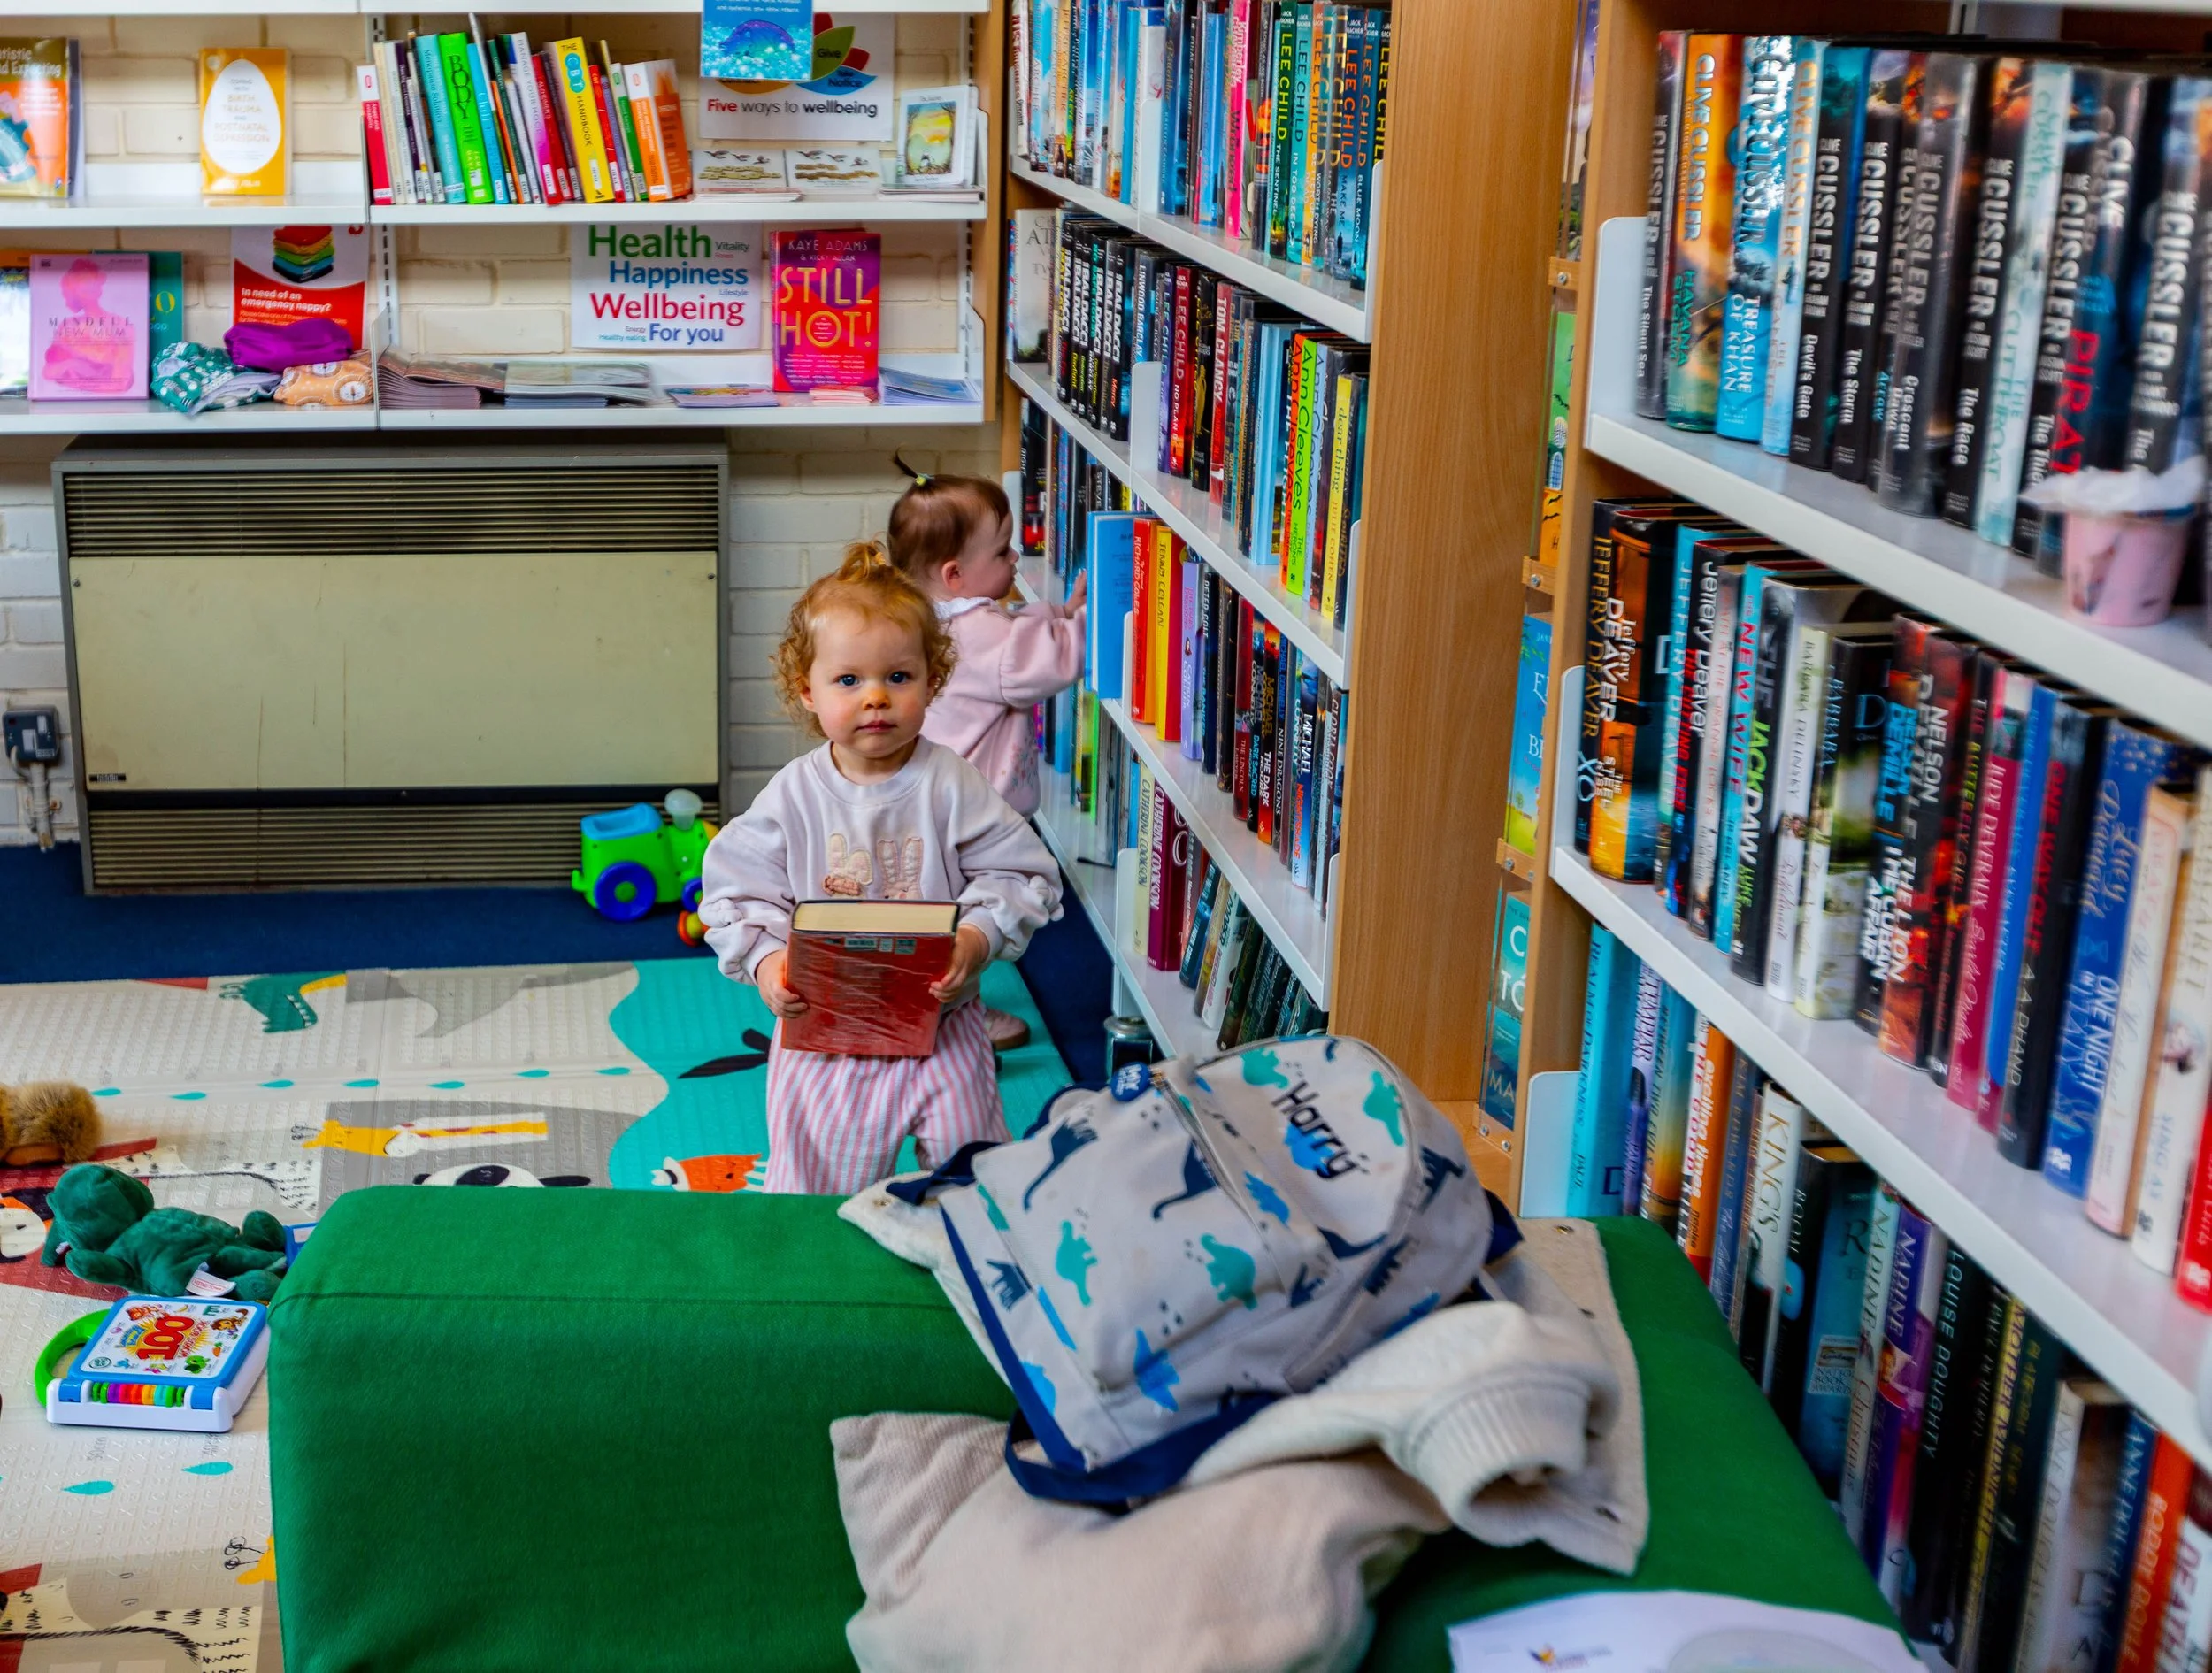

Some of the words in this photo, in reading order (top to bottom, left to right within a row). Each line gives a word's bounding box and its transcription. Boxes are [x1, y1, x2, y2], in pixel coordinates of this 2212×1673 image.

[817, 48, 841, 58] Give
[827, 78, 863, 88] Notice
[1280, 33, 1293, 74] LEE
[1298, 40, 1309, 76] LEE
[1344, 49, 1357, 91] LEE
[1362, 44, 1373, 87] LEE
[449, 55, 472, 119] BODY
[708, 98, 737, 112] Five
[742, 100, 780, 117] ways
[785, 100, 798, 113] to
[804, 99, 878, 118] wellbeing
[1277, 80, 1290, 141] CHILD
[1294, 81, 1308, 142] CHILD
[1309, 82, 1321, 144] CHILD
[1694, 53, 1716, 125] CLIVE
[1797, 58, 1818, 134] CLIVE
[577, 96, 593, 147] HANDBOOK
[1340, 97, 1356, 168] CHILD
[1356, 94, 1371, 167] CHILD
[1271, 166, 1280, 214] SENTINEL
[1292, 152, 1298, 165] IN
[1647, 130, 1668, 247] CUSSLER
[1683, 130, 1711, 242] CUSSLER
[1339, 210, 1345, 227] ME
[1354, 207, 1363, 242] MOON
[1780, 139, 1809, 257] CUSSLER
[1809, 154, 1840, 280] CUSSLER
[1852, 158, 1886, 288] CUSSLER
[588, 224, 711, 258] Health
[715, 241, 750, 252] Vitality
[788, 240, 819, 252] KAYE
[826, 241, 868, 252] ADAMS
[1969, 178, 2011, 317] CUSSLER
[2045, 191, 2087, 341] CUSSLER
[241, 298, 294, 310] emergency
[296, 301, 332, 312] nappy?
[252, 289, 273, 299] need
[275, 290, 287, 299] of
[610, 260, 749, 289] Happiness
[780, 266, 872, 304] STILL
[1073, 258, 1083, 342] BALDACCI
[2142, 211, 2194, 370] CUSSLER
[49, 317, 134, 326] MINDFUL
[589, 292, 744, 326] Wellbeing
[649, 323, 680, 342] For
[687, 326, 724, 345] you
[780, 310, 872, 348] HOT!
[1094, 267, 1104, 354] BALDACCI
[1112, 273, 1124, 363] BALDACCI
[1134, 312, 1145, 357] BARCLAY
[1179, 295, 1187, 326] LEE
[1219, 296, 1228, 325] TOM
[1677, 269, 1696, 366] HAVANA
[1732, 293, 1747, 324] OF
[1175, 330, 1186, 380] CHILD
[1214, 334, 1227, 402] CLANCY
[1299, 344, 1316, 395] Ann
[1722, 330, 1743, 394] KHAN
[1736, 295, 1762, 395] TREASURE
[1801, 334, 1819, 380] Devil's
[1847, 349, 1863, 376] The
[1338, 407, 1348, 445] dear
[1795, 383, 1812, 419] Gate
[1840, 378, 1859, 424] Storm
[1899, 373, 1919, 451] Crescent
[1957, 388, 1979, 418] The
[1986, 310, 2022, 483] CUTTHROAT
[2050, 329, 2100, 475] PIRAT
[1292, 397, 1312, 510] Cleeves
[1329, 447, 1346, 497] thing
[1953, 425, 1976, 467] Race
[1157, 576, 1166, 628] COLGAN
[1587, 536, 1613, 634] JEFFERY
[1598, 597, 1624, 722] DEAVER
[1615, 618, 1639, 682] Jeffery
[1736, 622, 1757, 703] NEW
[1795, 641, 1816, 714] BARBARA
[1582, 638, 1607, 739] DEAVER
[1690, 648, 1714, 739] Deaver
[1302, 713, 1315, 774] MICHAEL
[1820, 676, 1845, 767] BARBARA
[1249, 760, 1258, 798] SACRED
[1274, 756, 1284, 816] DRAGONS
[1576, 751, 1598, 802] XO
[1726, 712, 1749, 796] WIFE
[1786, 719, 1808, 801] DELINSKY
[1919, 705, 1950, 803] NELSON
[1141, 779, 1151, 840] CATHERINE
[1740, 713, 1770, 866] JACKDAW
[1985, 762, 2007, 812] JUDE
[2044, 759, 2069, 824] ONE
[1153, 787, 1164, 856] CATHERINE
[1294, 783, 1304, 860] NIGHTSHADE
[1137, 840, 1148, 888] COOKSON
[1151, 856, 1163, 910] COOKSON
[1896, 856, 1917, 905] THE
[1972, 812, 2000, 911] DEVERAUX
[2035, 832, 2057, 890] WAY
[1860, 875, 1886, 961] AFFAIR
[1887, 906, 1913, 984] LION
[2028, 891, 2050, 955] OUT
[1639, 976, 1660, 1063] TEMPLAR
[2092, 974, 2119, 1028] ONE
[2007, 1011, 2031, 1086] DHAND
[2081, 1031, 2115, 1099] NIGHT
[1272, 1080, 1360, 1180] Harry
[1700, 1059, 1716, 1140] exciting
[1686, 1095, 1701, 1174] GOOD
[1724, 1086, 1745, 1200] EDWARDS
[1690, 1143, 1709, 1199] times
[1758, 1111, 1790, 1235] KING'S
[1790, 1189, 1807, 1253] ROOM
[1862, 1201, 1891, 1329] NADINE
[1890, 1230, 1918, 1338] NADINE
[1940, 1250, 1966, 1339] LOUISE
[136, 1316, 195, 1360] 100
[2001, 1304, 2027, 1410] MOTHER
[1924, 1346, 1953, 1460] DOUGHTY
[1978, 1416, 2010, 1539] MIDNIGHT
[2160, 1539, 2202, 1663] DEATH
